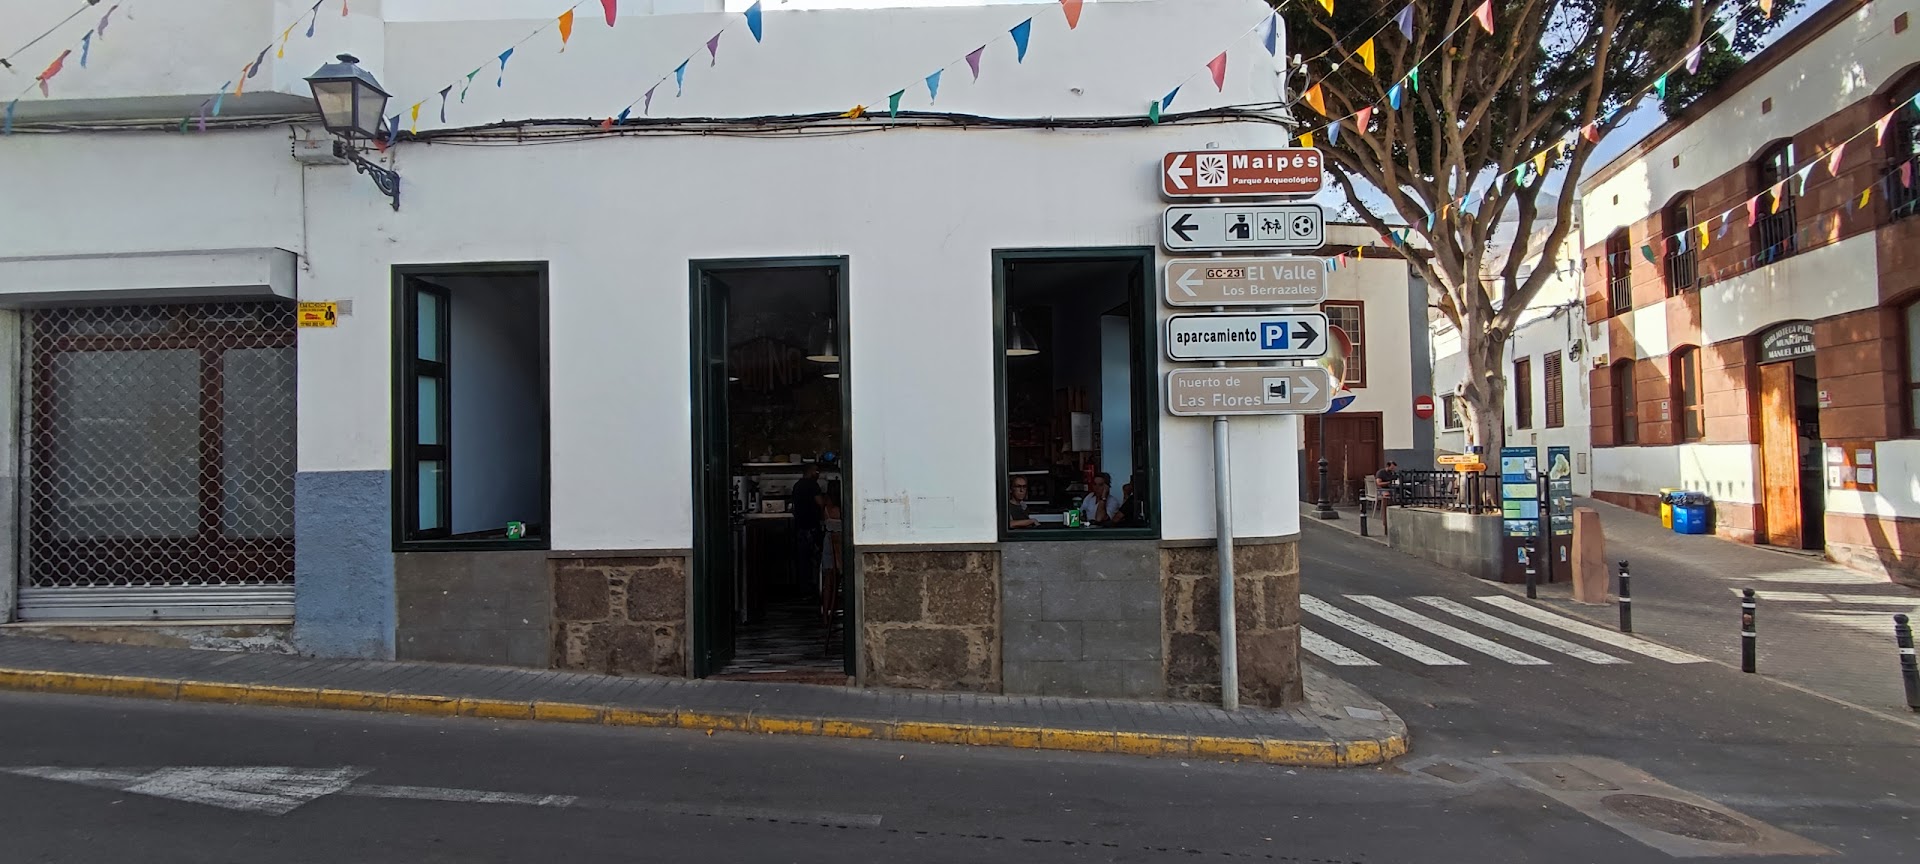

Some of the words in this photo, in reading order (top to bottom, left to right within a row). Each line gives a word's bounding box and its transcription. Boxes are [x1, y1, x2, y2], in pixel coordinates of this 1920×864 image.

[1232, 154, 1318, 171] Maipés
[1232, 177, 1262, 185] Parque
[1264, 176, 1319, 185] Arqueológico
[1207, 269, 1245, 278] GC-231
[1247, 266, 1265, 280] El
[1273, 266, 1316, 280] Valle
[1223, 285, 1245, 296] Los
[1250, 284, 1317, 295] Berrazales
[1177, 328, 1257, 346] aparcamiento
[1265, 325, 1283, 347] P
[1763, 325, 1797, 348] BIBLIOTECA
[1776, 335, 1809, 347] MUNICIPAL
[1768, 348, 1792, 358] MANUEL
[1794, 343, 1816, 354] ALEMÁ
[1178, 377, 1221, 388] huerto
[1225, 376, 1241, 387] de
[1179, 394, 1206, 407] Las
[1212, 393, 1262, 407] Flores
